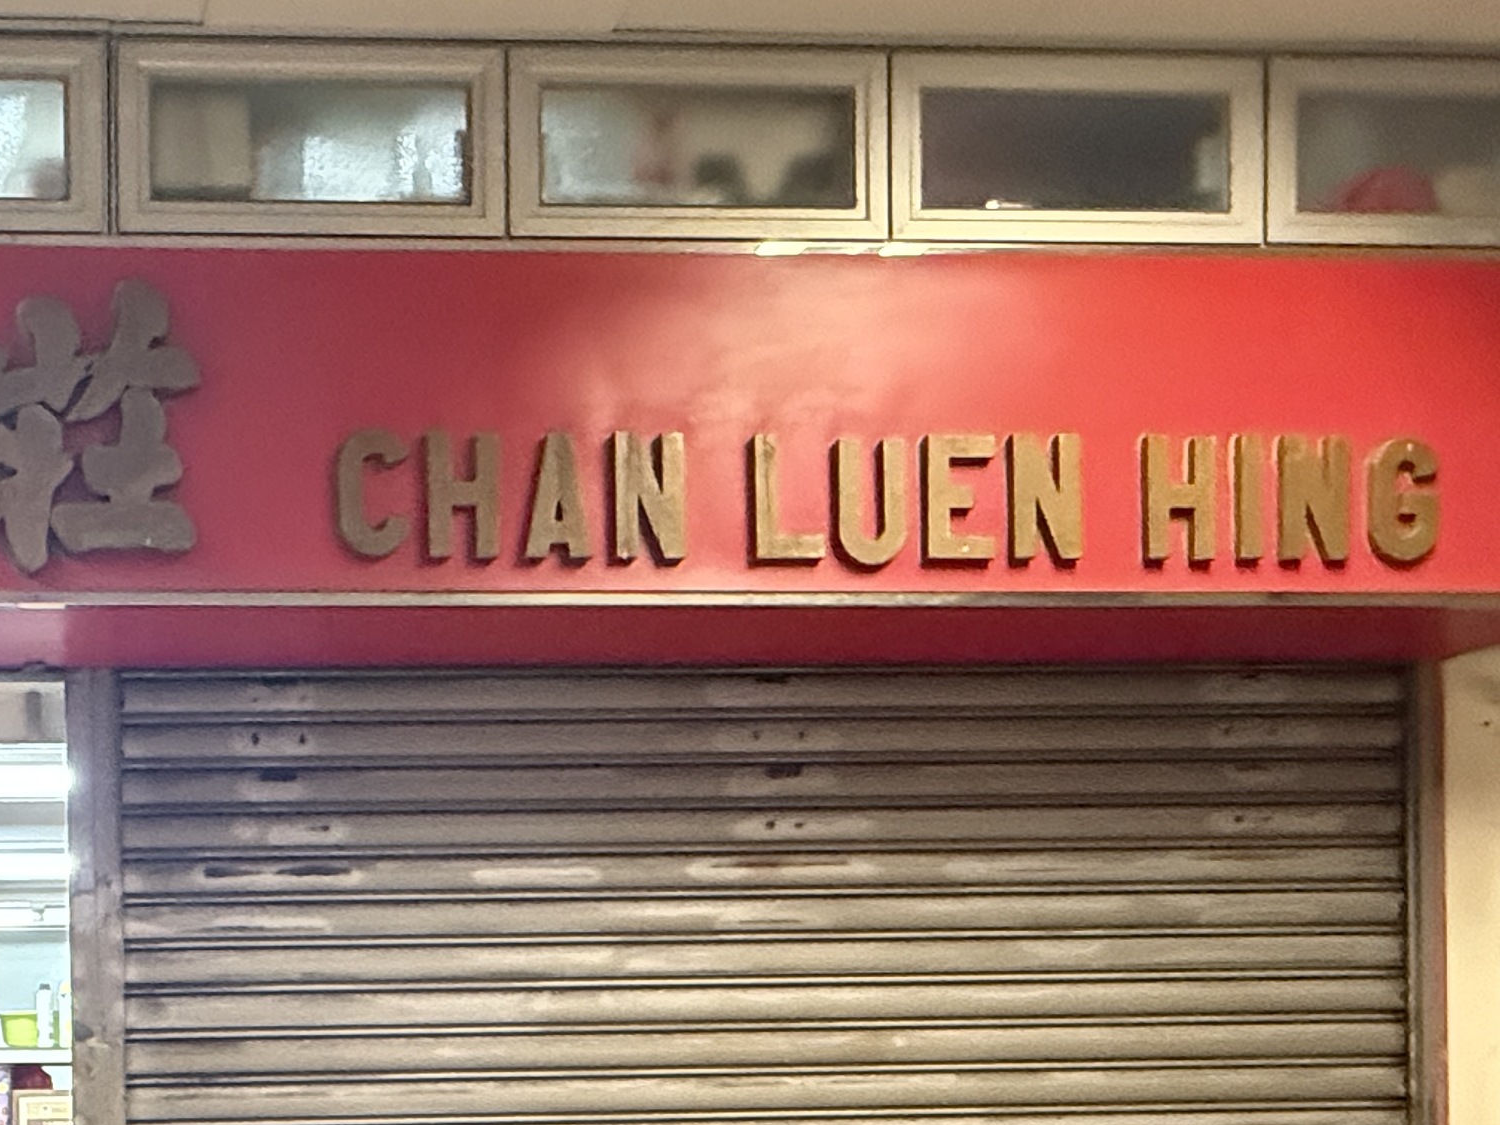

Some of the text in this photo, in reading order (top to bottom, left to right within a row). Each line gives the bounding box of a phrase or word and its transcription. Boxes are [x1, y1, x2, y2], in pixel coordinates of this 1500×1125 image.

[334, 429, 1441, 571] CHAN LUEN HING
